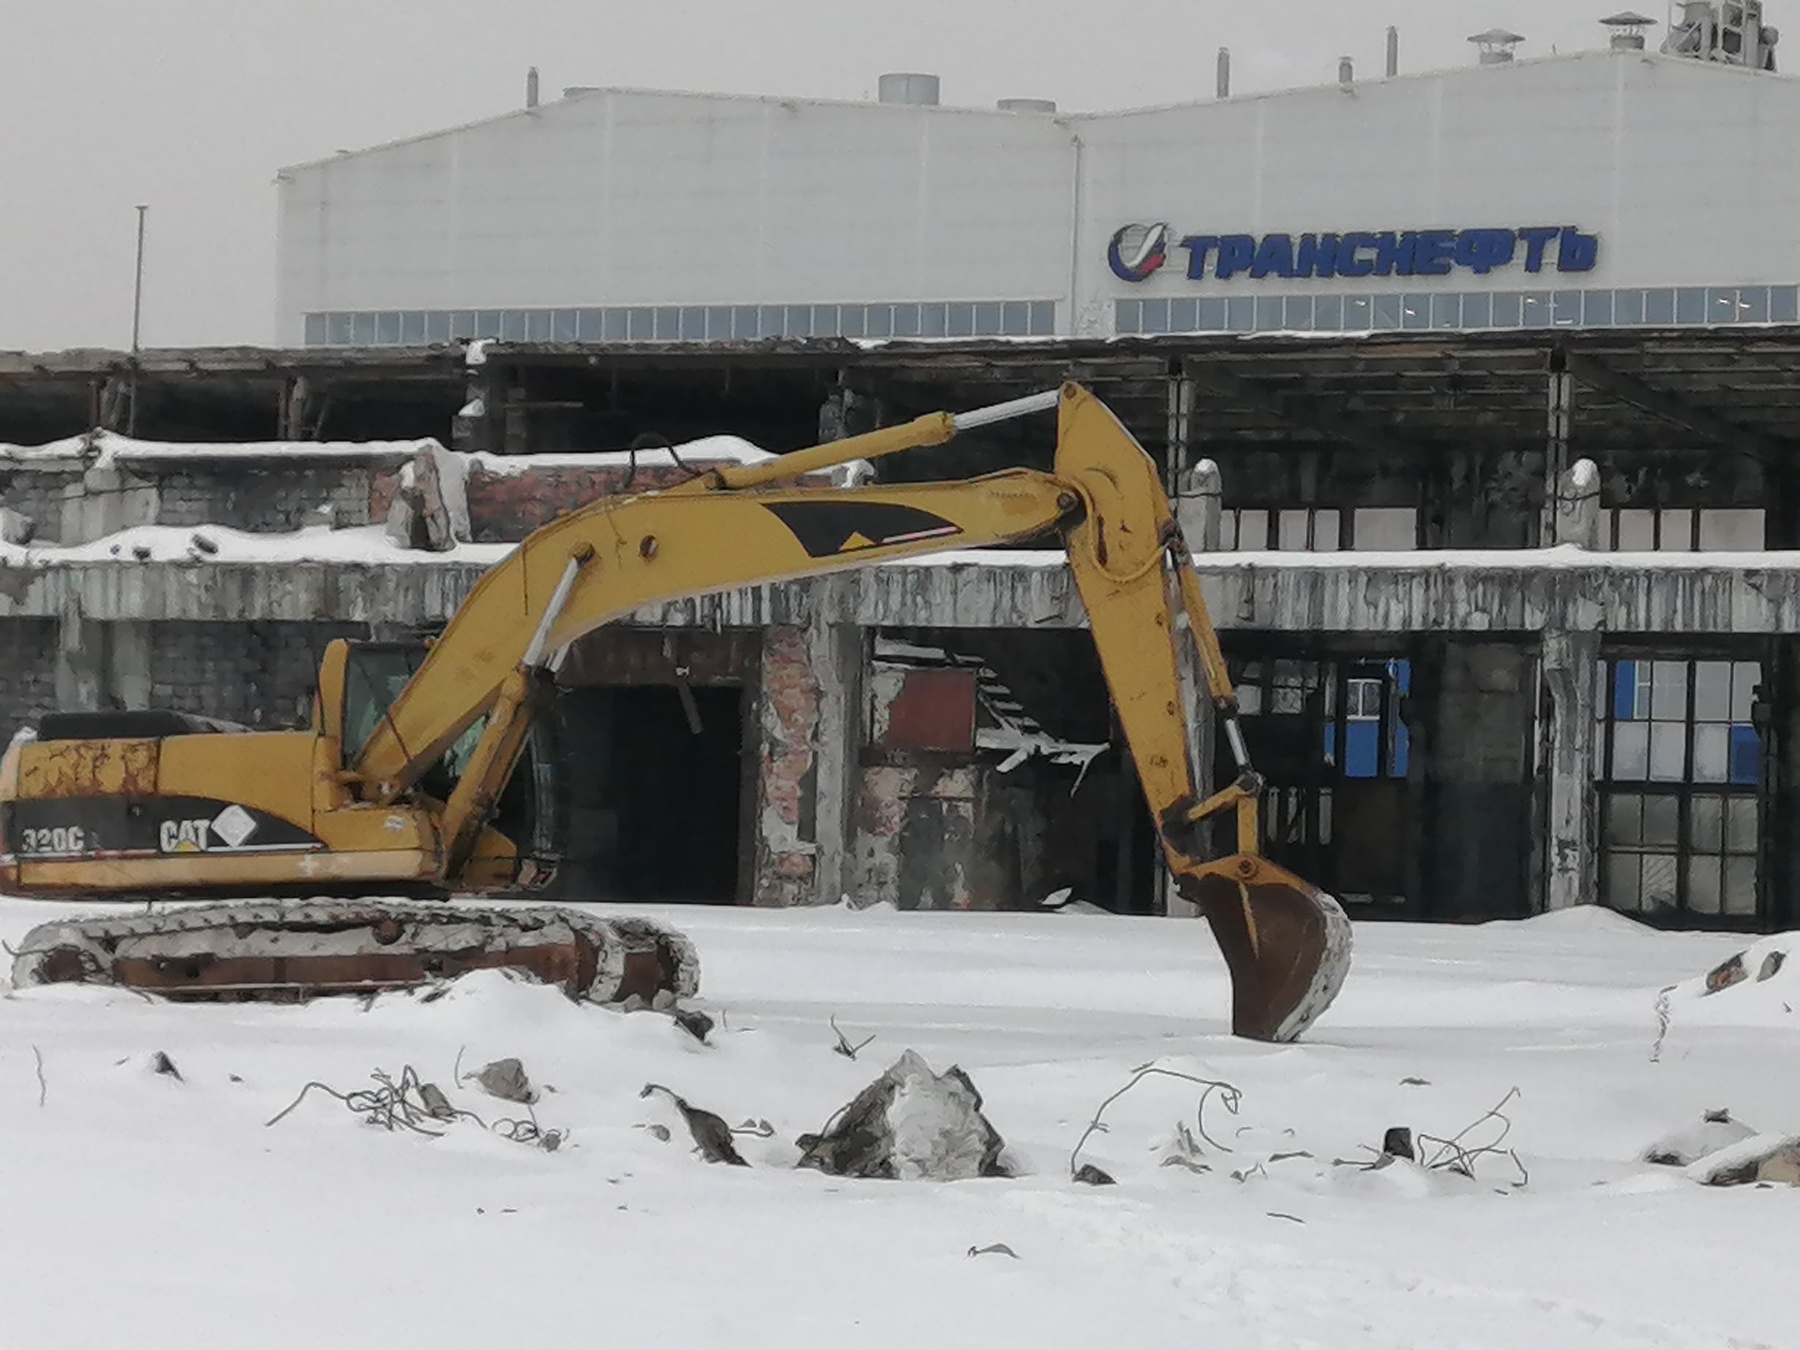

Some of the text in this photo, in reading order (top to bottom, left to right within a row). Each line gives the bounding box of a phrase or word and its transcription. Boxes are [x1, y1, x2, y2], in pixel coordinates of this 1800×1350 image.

[1180, 226, 1598, 280] ТРАНСНЕФТЬ
[22, 826, 85, 851] 320C
[160, 819, 209, 851] CAT
